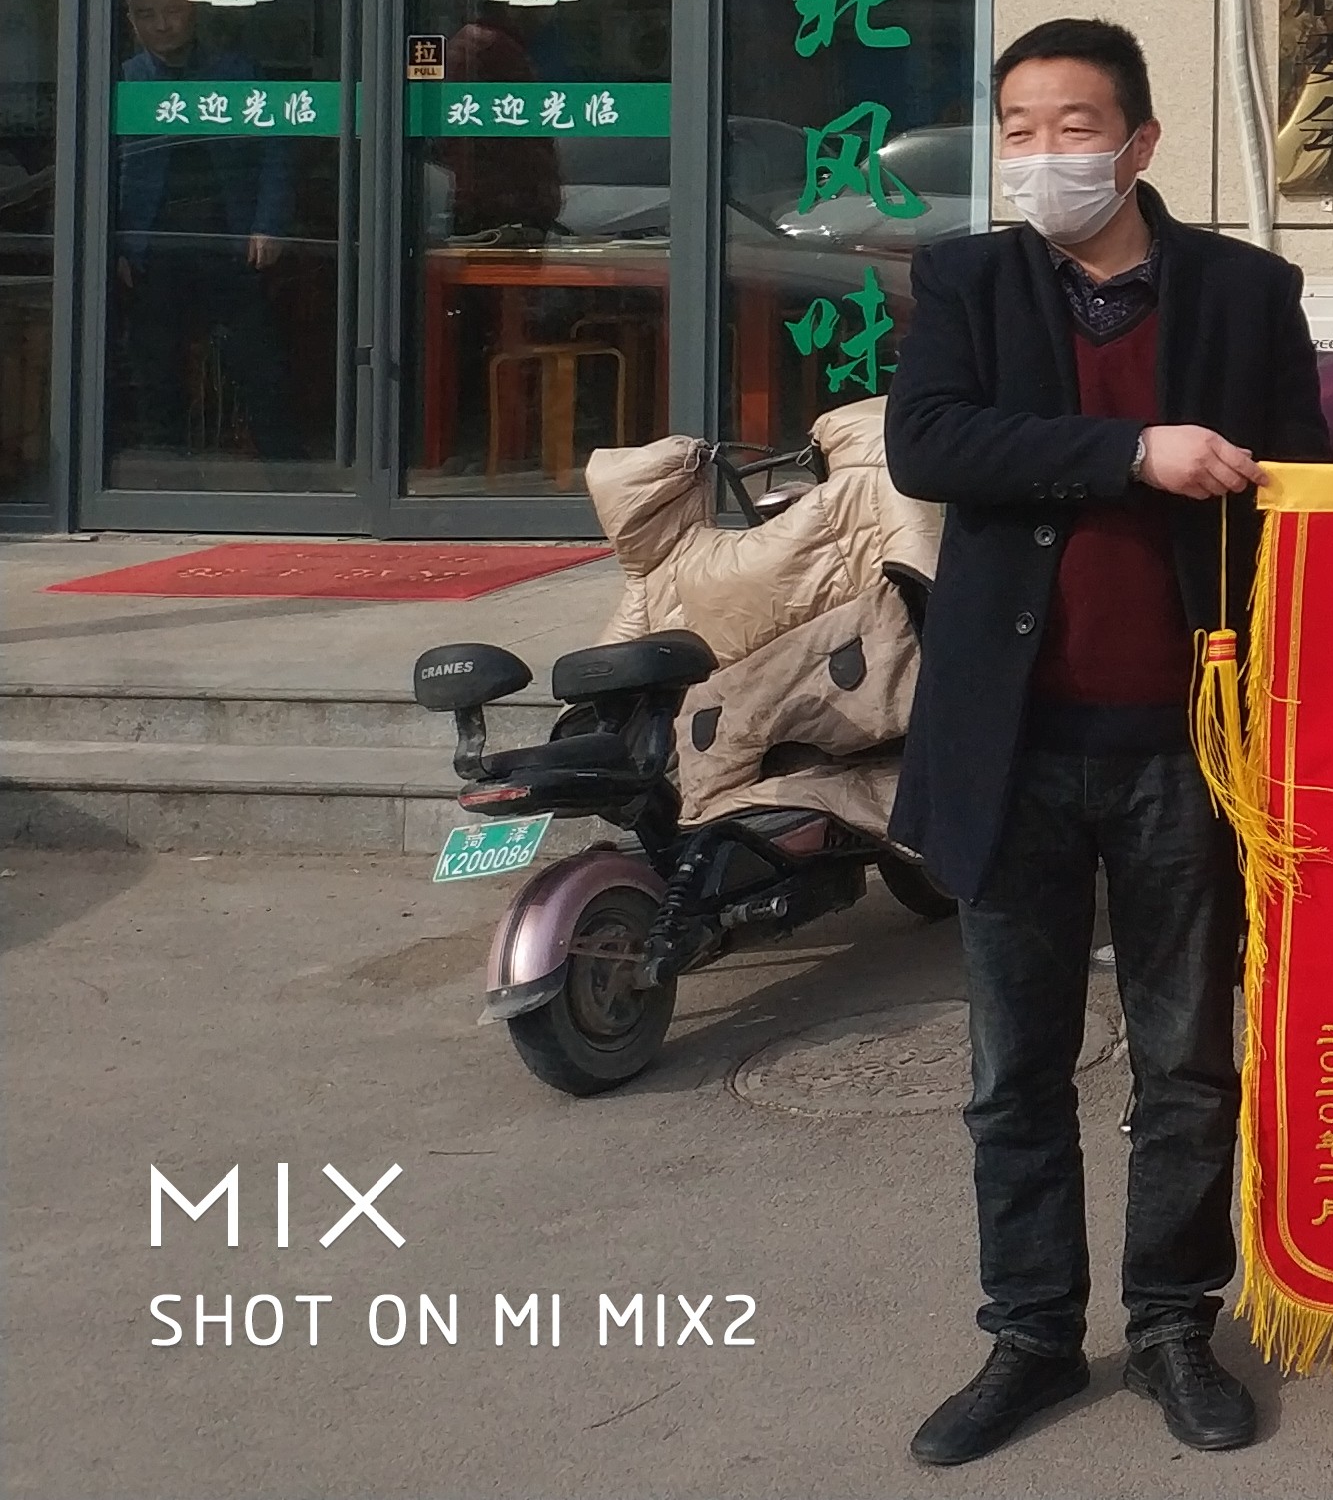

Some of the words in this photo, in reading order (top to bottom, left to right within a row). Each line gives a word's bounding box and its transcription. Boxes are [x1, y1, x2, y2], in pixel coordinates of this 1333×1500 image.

[414, 41, 437, 63] 拉
[413, 67, 437, 76] PULL
[155, 89, 318, 128] 欢迎光临
[446, 91, 620, 129] 欢迎光临
[420, 660, 475, 681] CRANES
[439, 840, 535, 877] K200086
